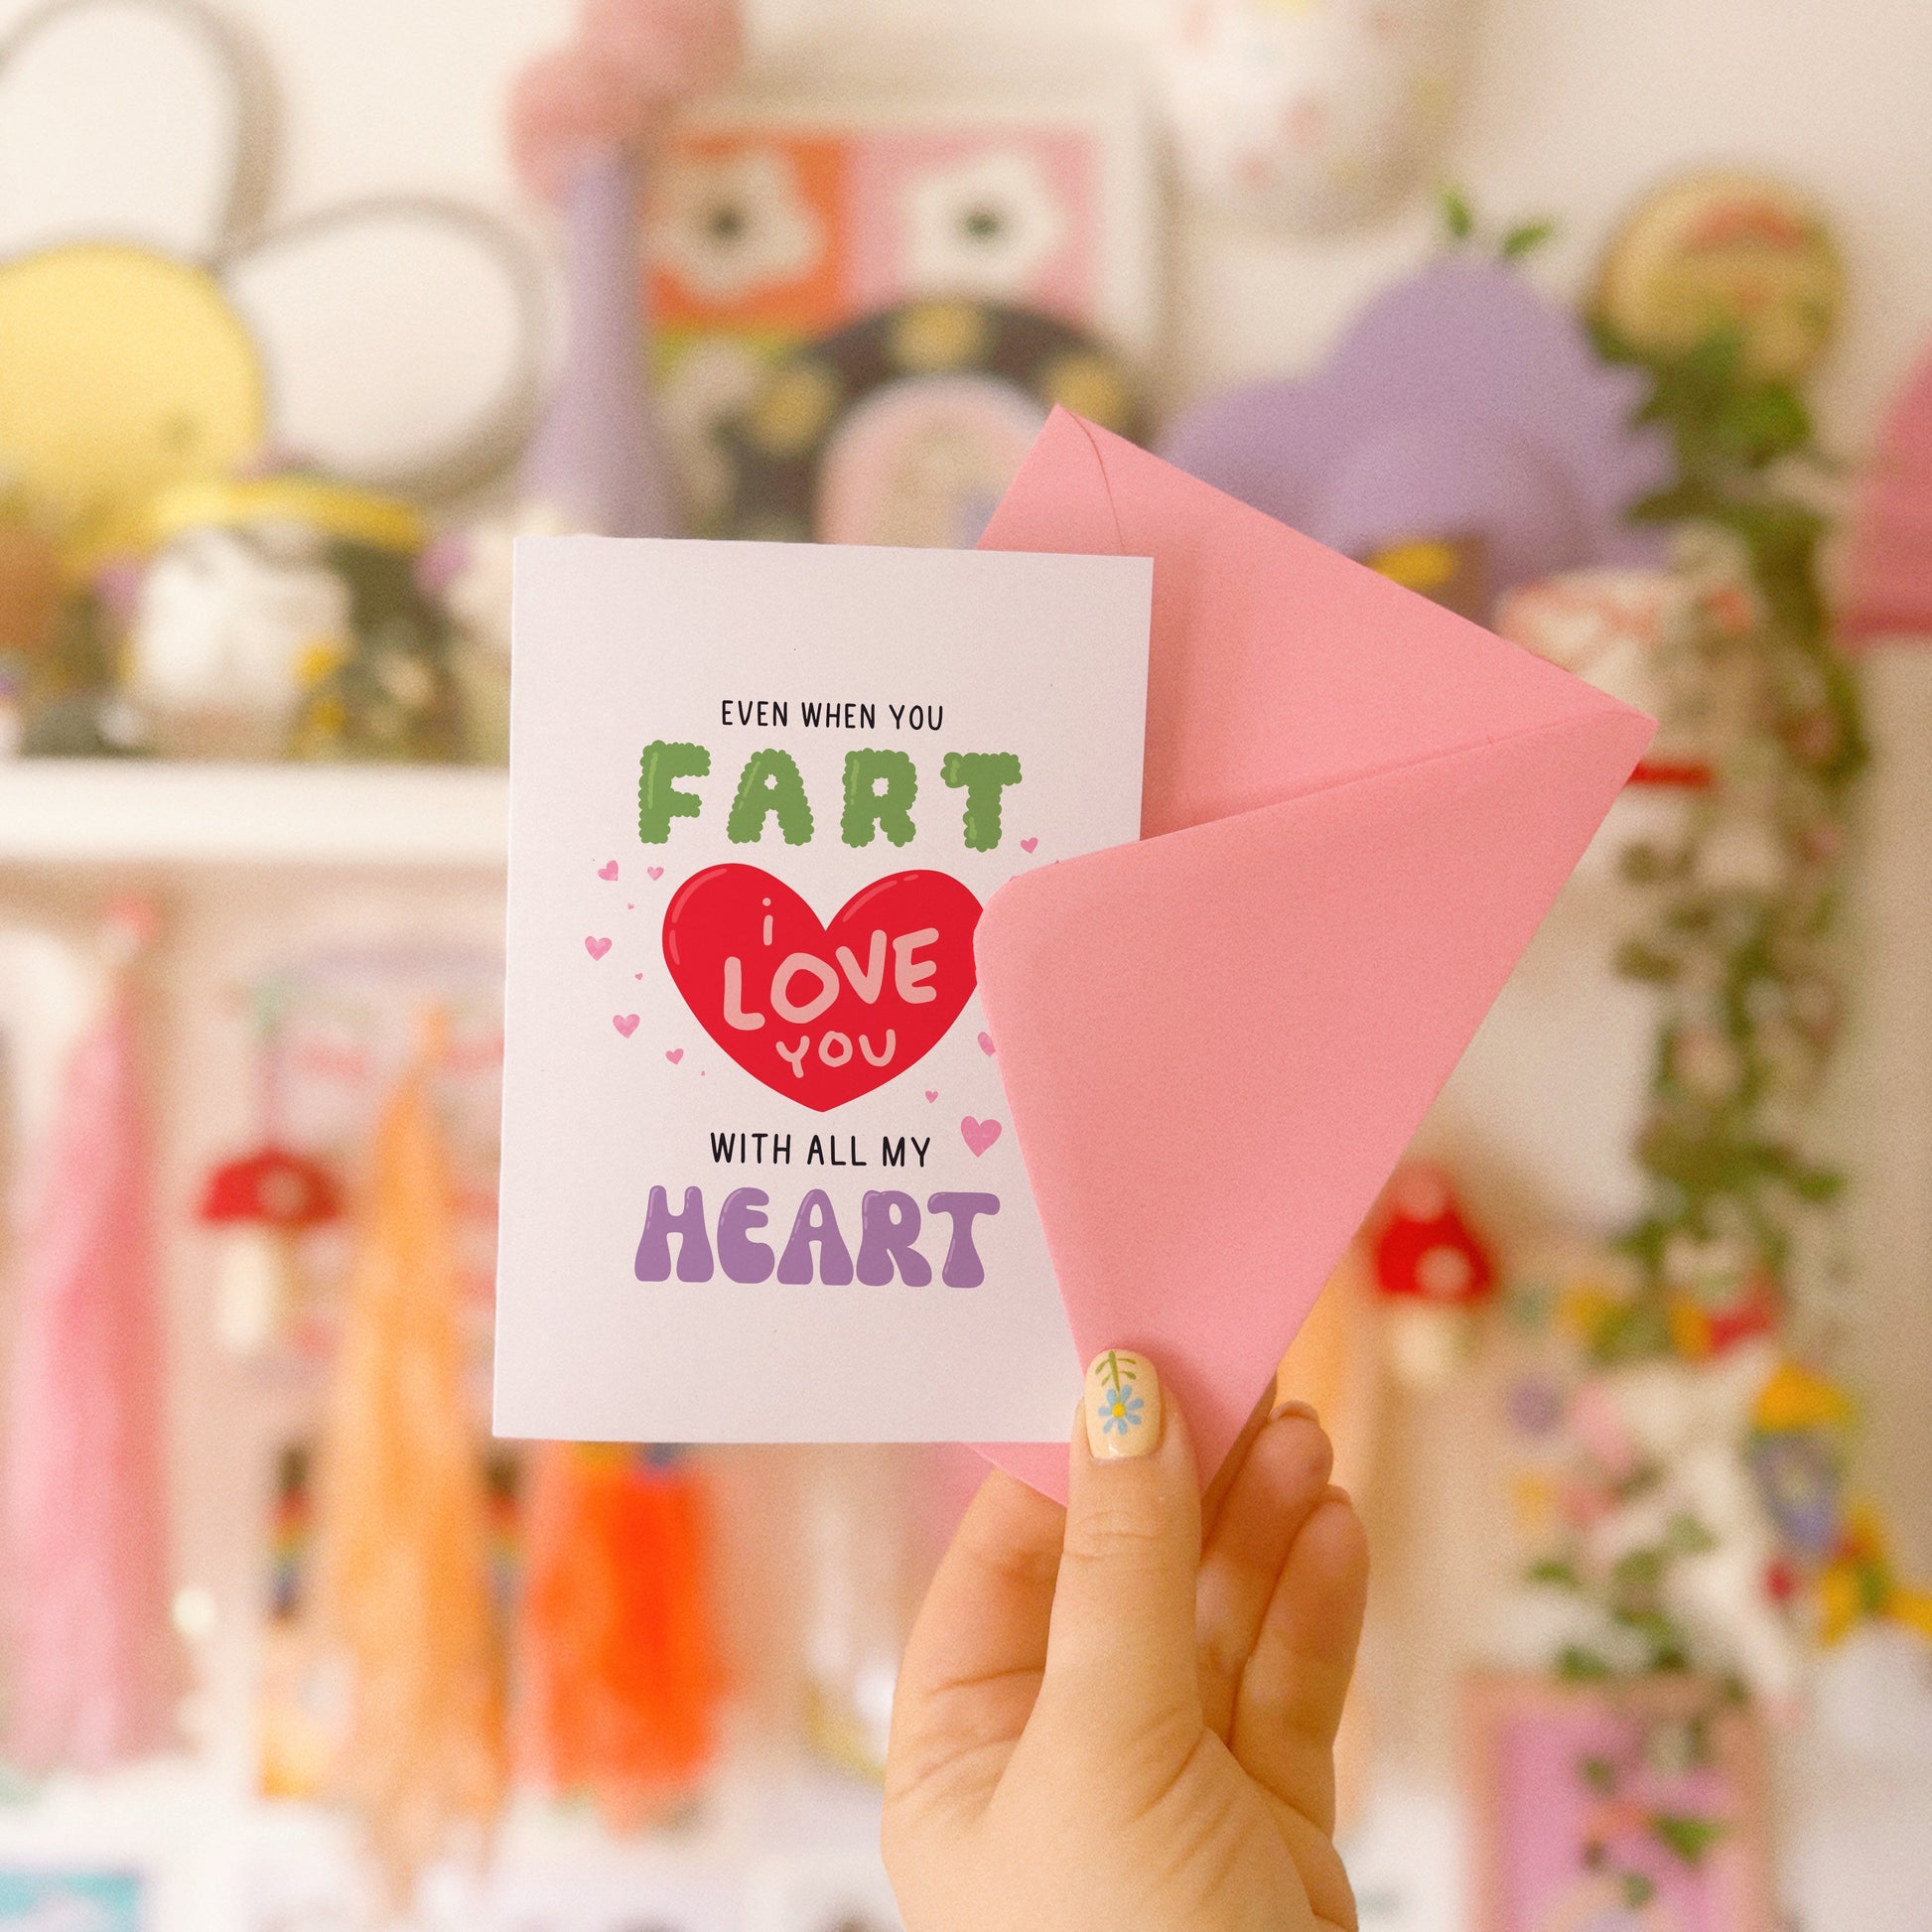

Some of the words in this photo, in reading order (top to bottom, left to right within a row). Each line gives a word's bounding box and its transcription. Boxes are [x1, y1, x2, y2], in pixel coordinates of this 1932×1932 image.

[723, 700, 787, 727] EVEN
[801, 702, 875, 729] WHEN
[890, 705, 942, 731] YOU
[639, 741, 1021, 851] FART
[761, 897, 773, 946] i
[724, 927, 940, 1031] LOVE
[775, 1029, 897, 1078] YOU
[711, 1133, 790, 1164] WITH
[807, 1135, 867, 1166] ALL
[883, 1137, 930, 1168] MY
[634, 1185, 1000, 1288] HEART
